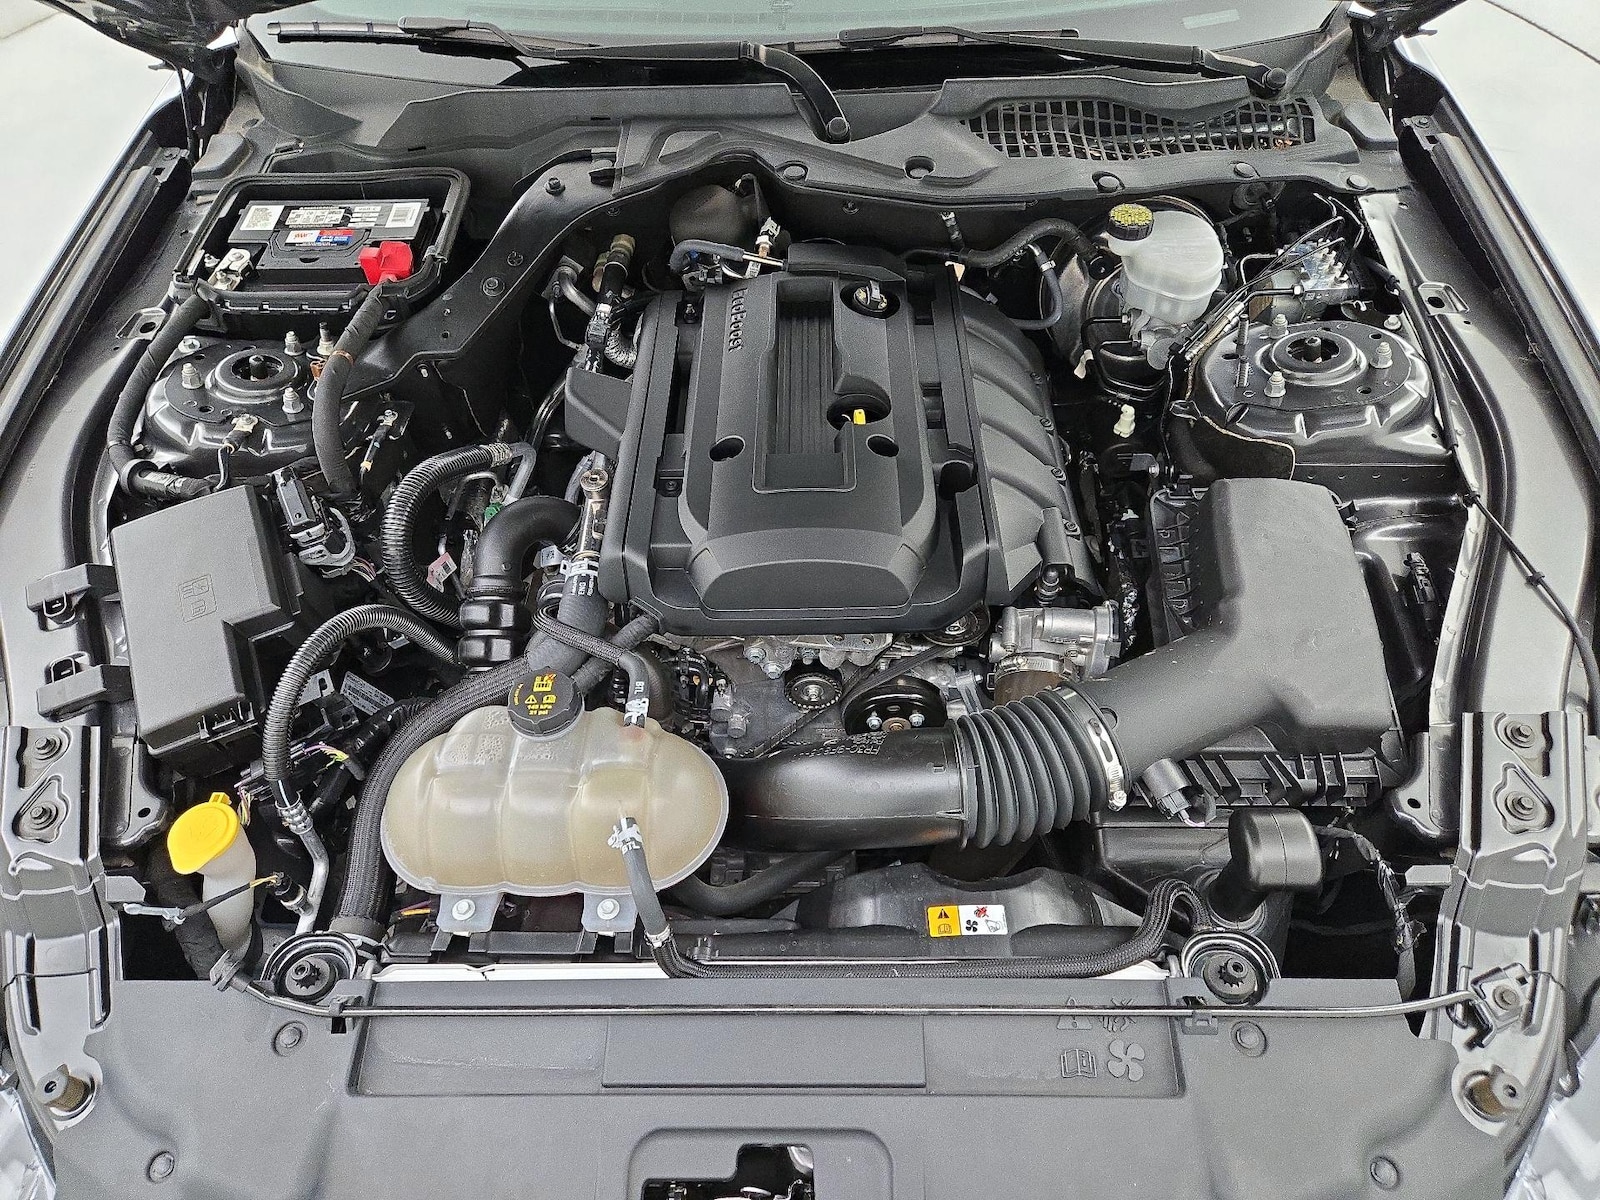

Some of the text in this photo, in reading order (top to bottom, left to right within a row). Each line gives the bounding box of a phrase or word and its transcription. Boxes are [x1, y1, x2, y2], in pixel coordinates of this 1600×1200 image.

[577, 582, 586, 595] ENG
[634, 681, 645, 695] BTL
[621, 841, 640, 855] BTL
